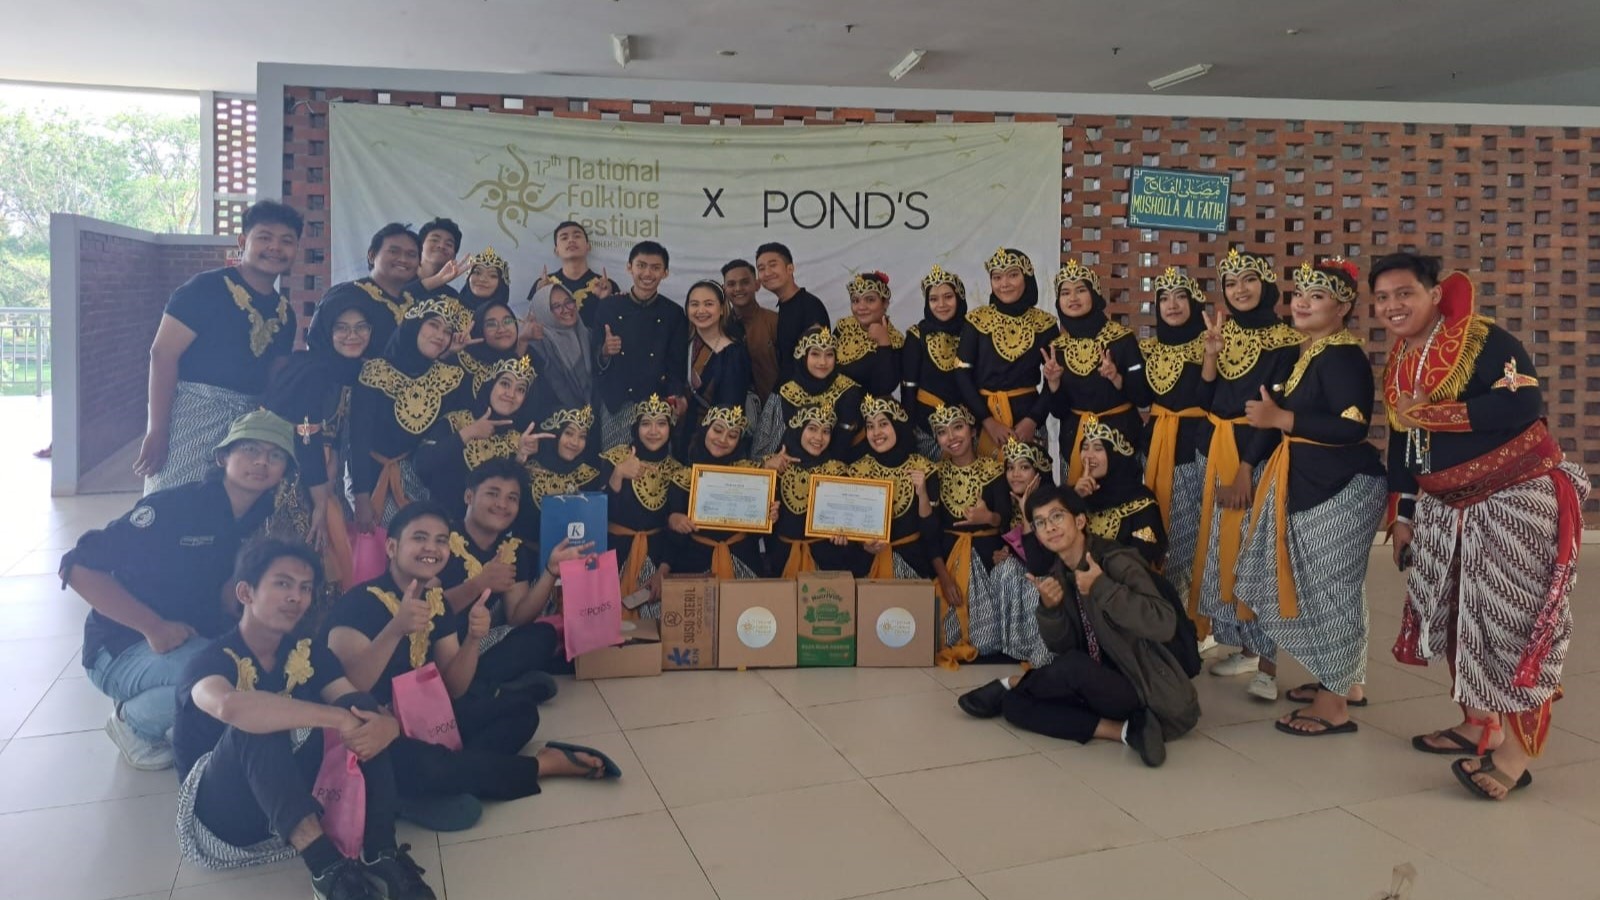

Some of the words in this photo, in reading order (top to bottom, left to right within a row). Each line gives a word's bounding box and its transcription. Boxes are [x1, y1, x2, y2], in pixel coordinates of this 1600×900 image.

[567, 156, 659, 181] National
[567, 183, 659, 209] Folklore
[1132, 194, 1180, 217] MUSHOLLA
[1184, 199, 1195, 218] AL
[1197, 200, 1224, 220] FATIH
[763, 190, 930, 230] POND'S
[683, 586, 696, 618] STERIL
[683, 621, 695, 644] SUSU
